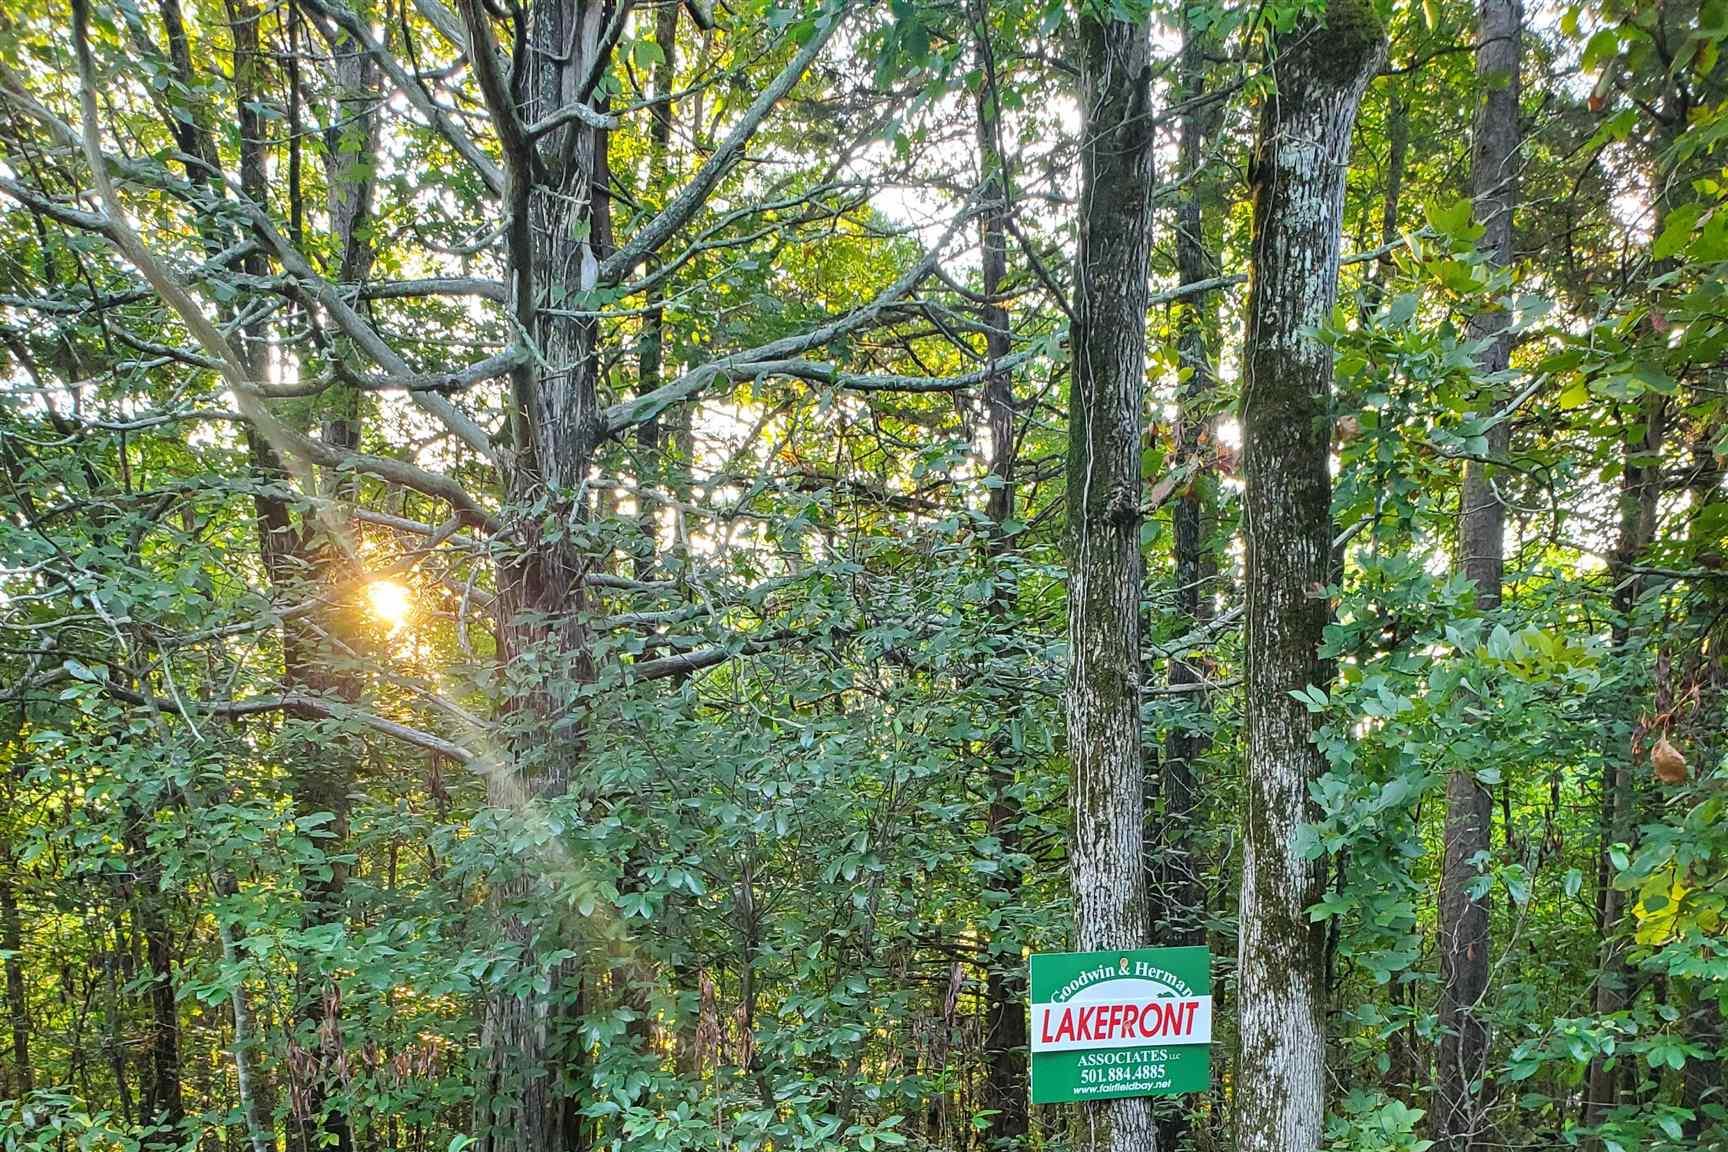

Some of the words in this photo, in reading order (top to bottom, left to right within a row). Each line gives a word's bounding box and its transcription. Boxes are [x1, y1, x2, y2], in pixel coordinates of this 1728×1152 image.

[1051, 965, 1115, 1003] Goodwin
[1041, 1002, 1199, 1043] LAKEFRONT
[1078, 1049, 1168, 1067] ASSOCIATES
[1081, 1064, 1165, 1083] 501.884.4885
[1073, 1081, 1171, 1094] www.fairfieldbay.net
